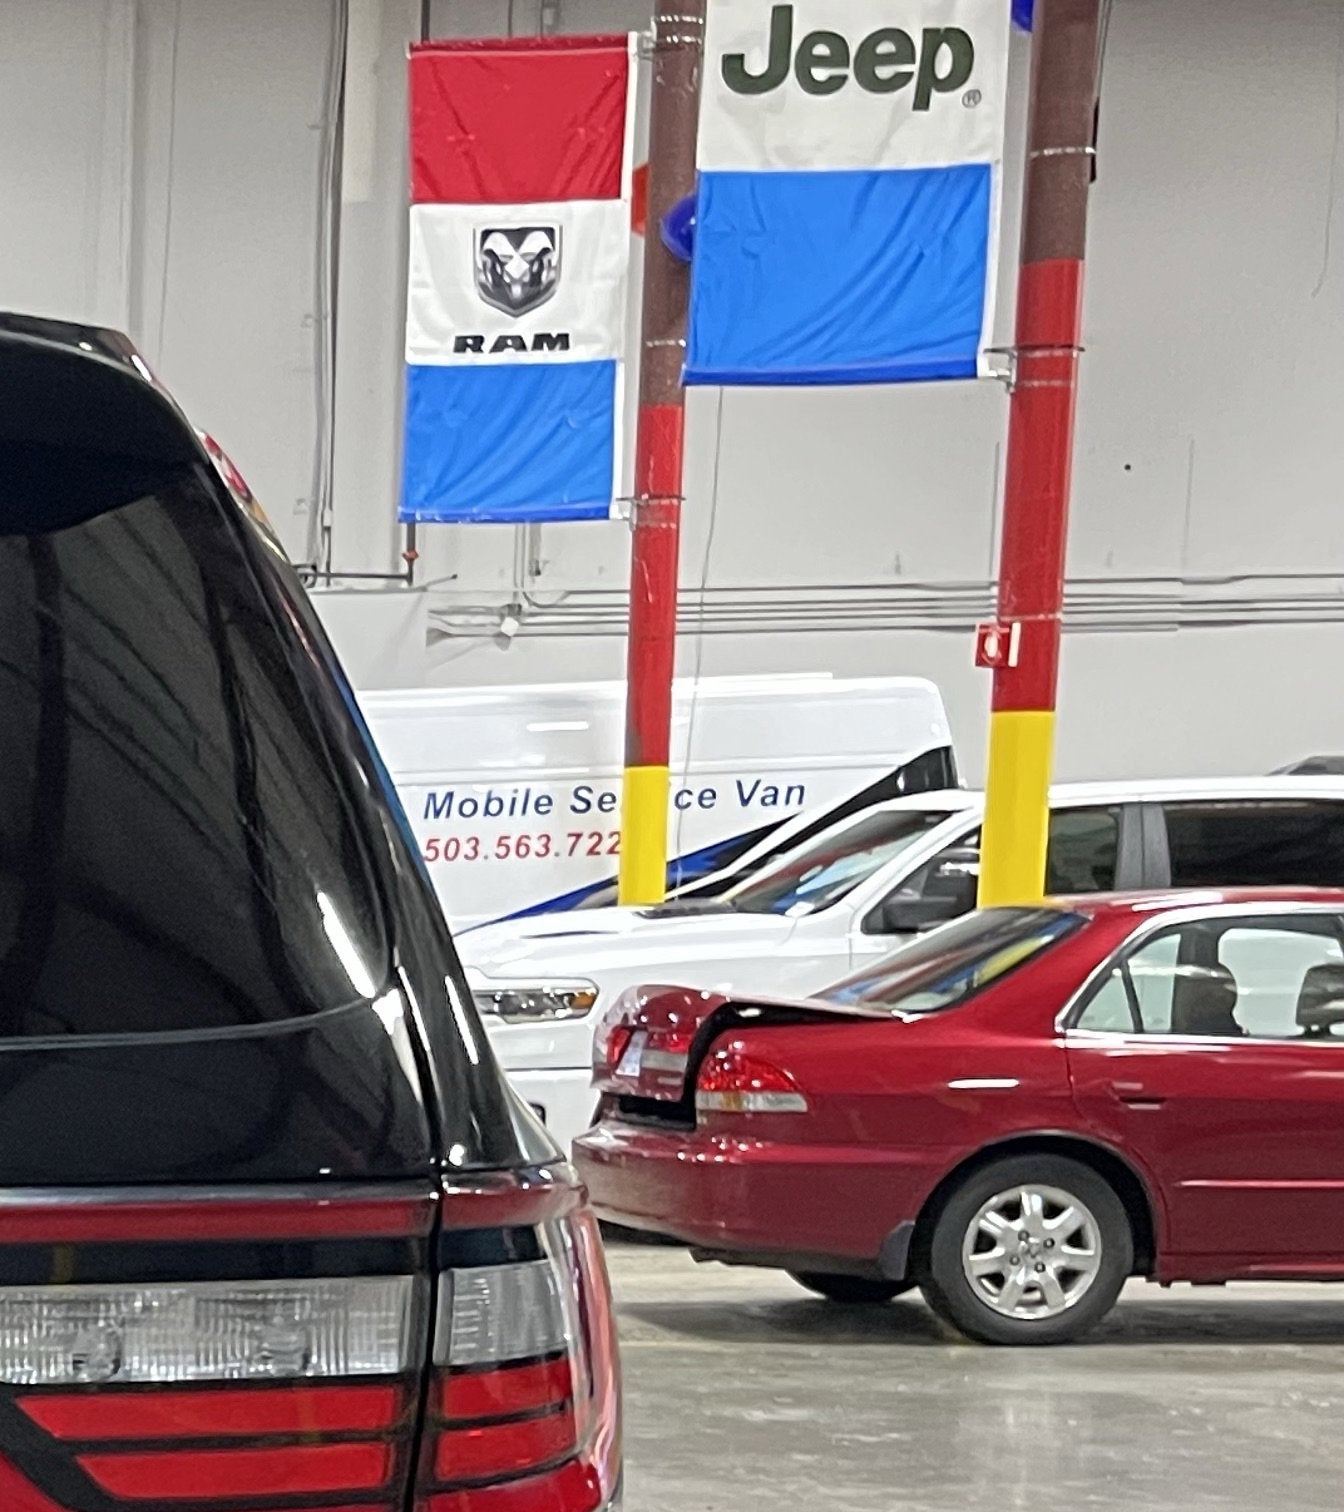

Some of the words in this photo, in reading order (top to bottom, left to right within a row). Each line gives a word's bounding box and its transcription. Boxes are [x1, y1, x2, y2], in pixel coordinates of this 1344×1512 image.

[721, 4, 974, 110] Jeep
[453, 332, 570, 353] RAM
[423, 788, 554, 819] Mobile
[570, 785, 717, 814] Sece
[735, 779, 806, 807] Van
